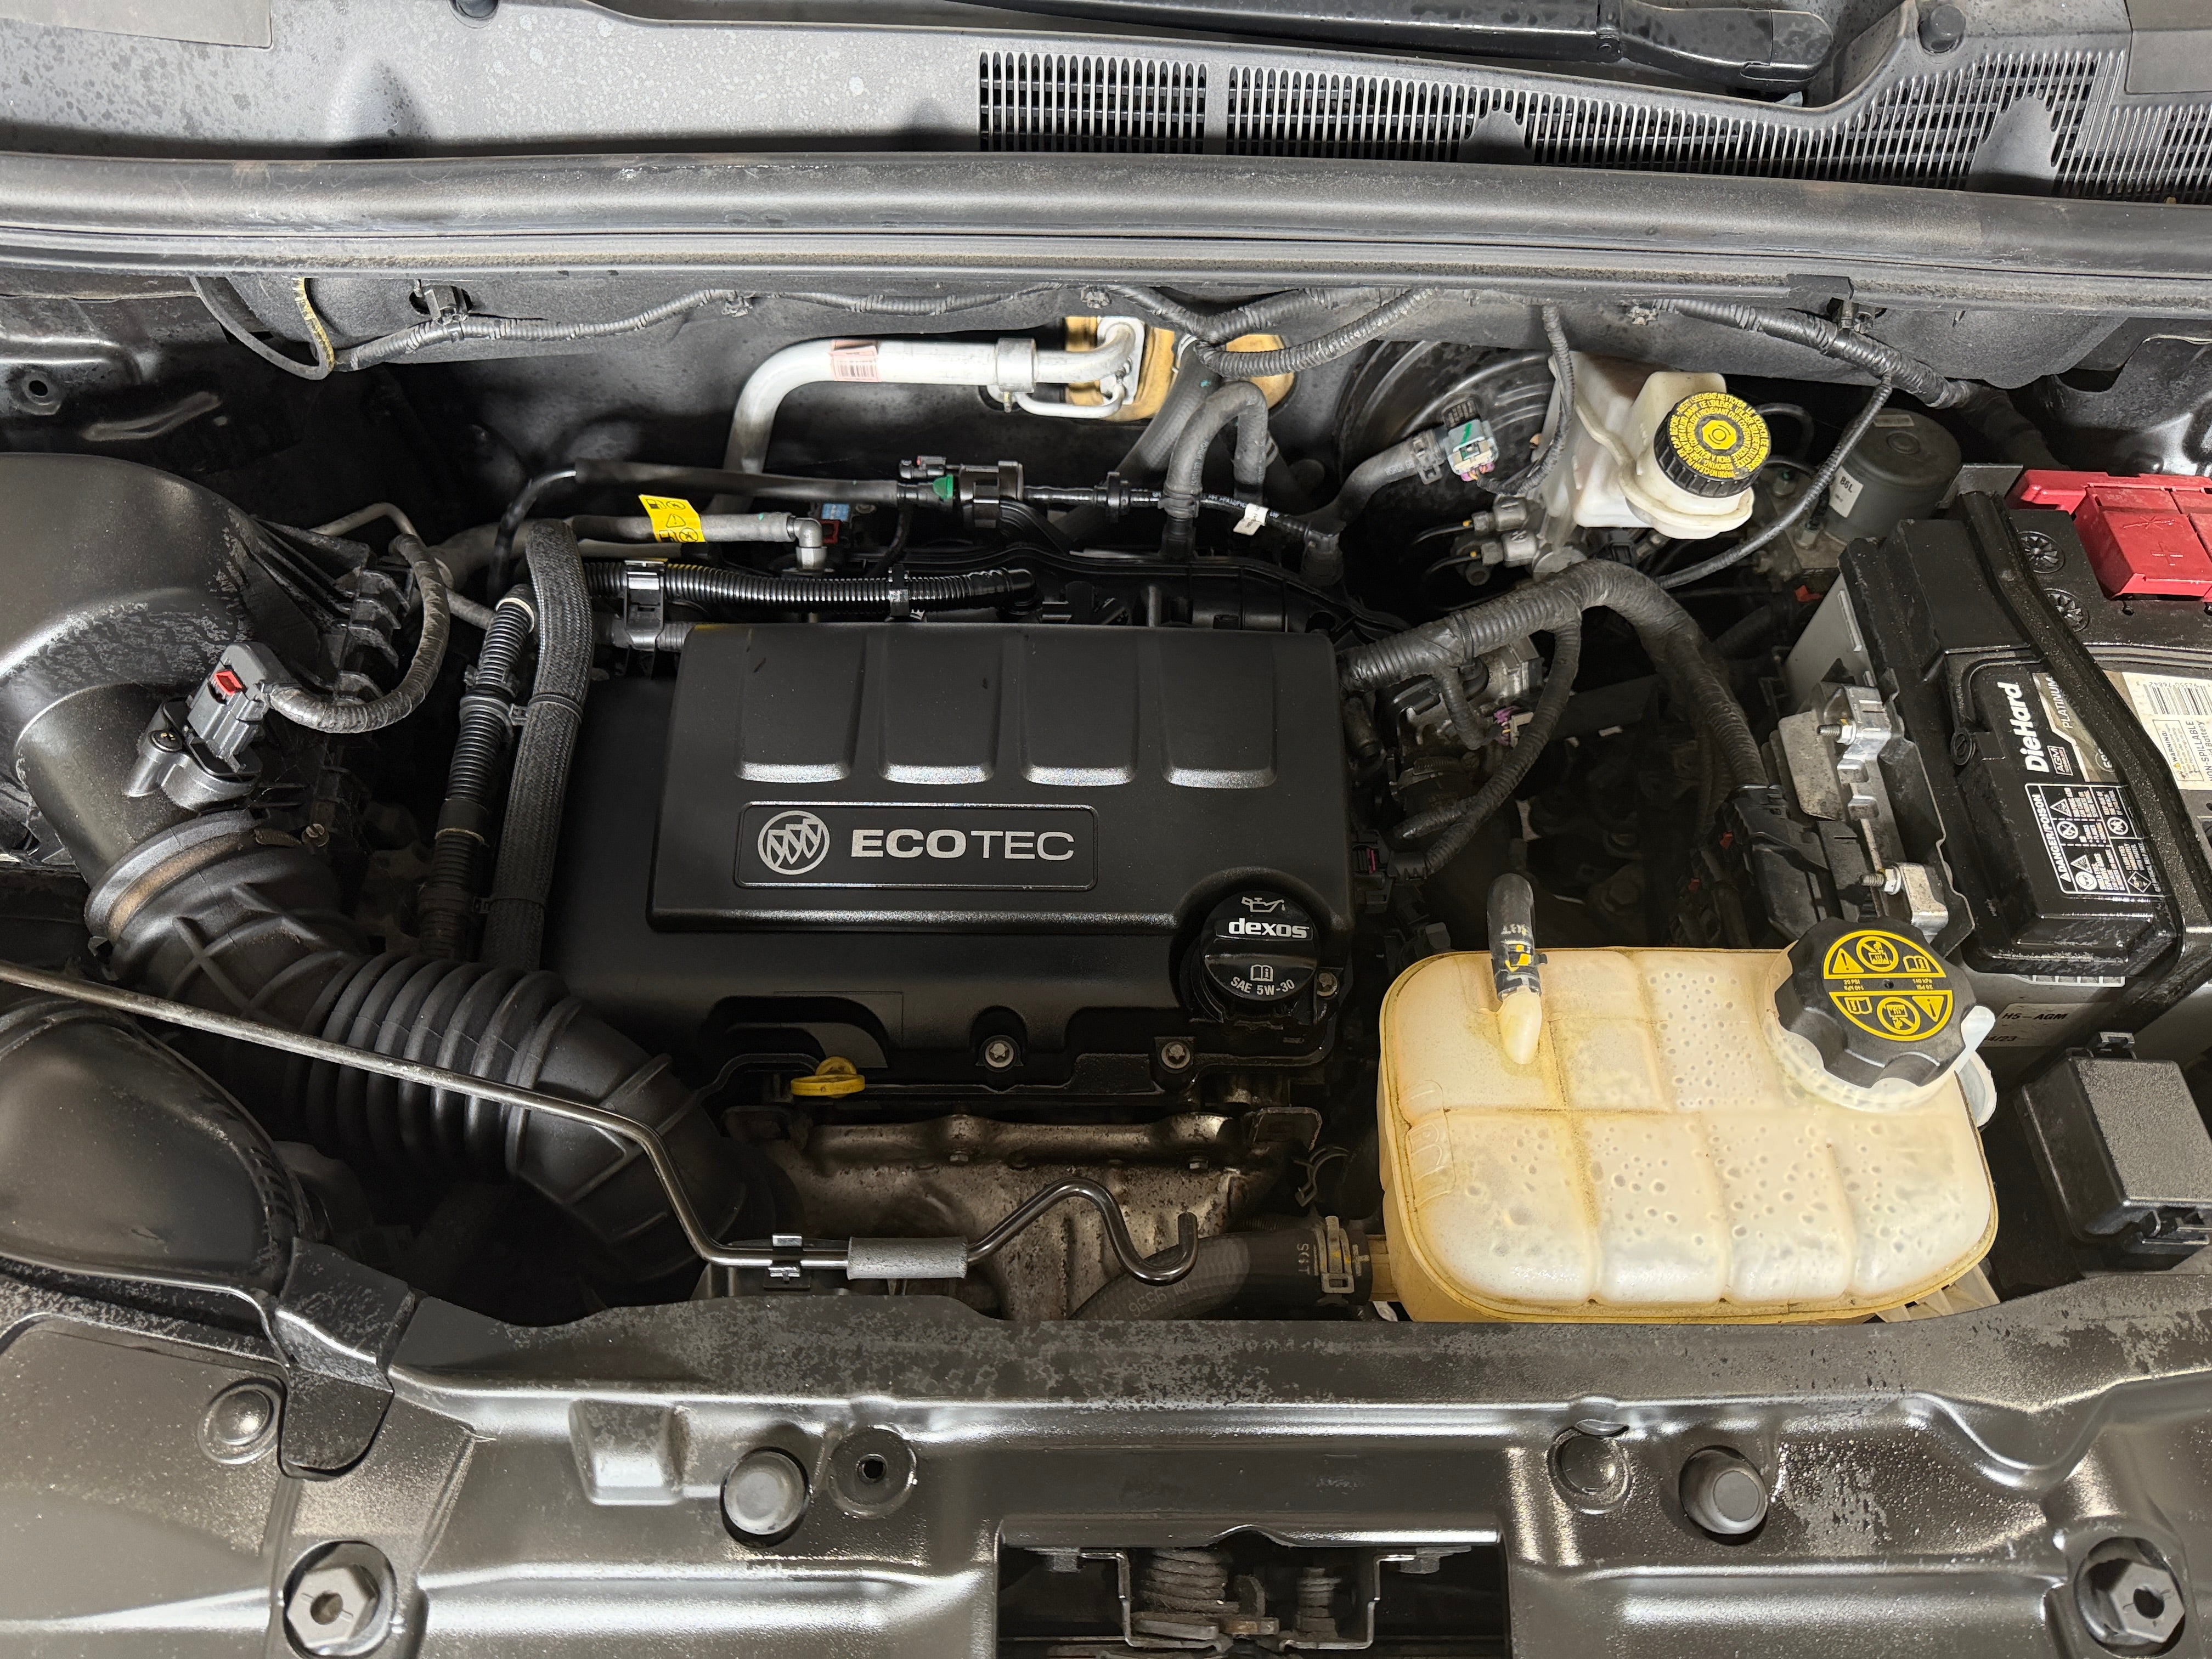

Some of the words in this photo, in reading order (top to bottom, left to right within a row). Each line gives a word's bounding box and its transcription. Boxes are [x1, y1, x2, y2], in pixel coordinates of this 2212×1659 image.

[1698, 400, 1708, 409] DE
[1669, 414, 1680, 436] BEFORE
[1745, 406, 1756, 415] LE
[1760, 438, 1769, 447] DE
[1670, 436, 1683, 450] CAP
[1678, 432, 1688, 442] DOT
[1675, 448, 1695, 467] FILLER
[1680, 441, 1694, 454] ONLY
[1689, 451, 1703, 464] USE
[1709, 454, 1716, 462] A
[2045, 676, 2073, 729] PLATINUM
[1997, 682, 2050, 772] DieHard
[2196, 720, 2212, 751] Battery
[2050, 748, 2066, 773] AGM
[2030, 794, 2068, 872] DANGER/POISON
[851, 828, 1075, 861] ECOTEC
[2117, 845, 2128, 856] EYES
[1228, 918, 1308, 939] dexos
[1231, 976, 1252, 994] SAE
[1256, 979, 1295, 996] 5W-30
